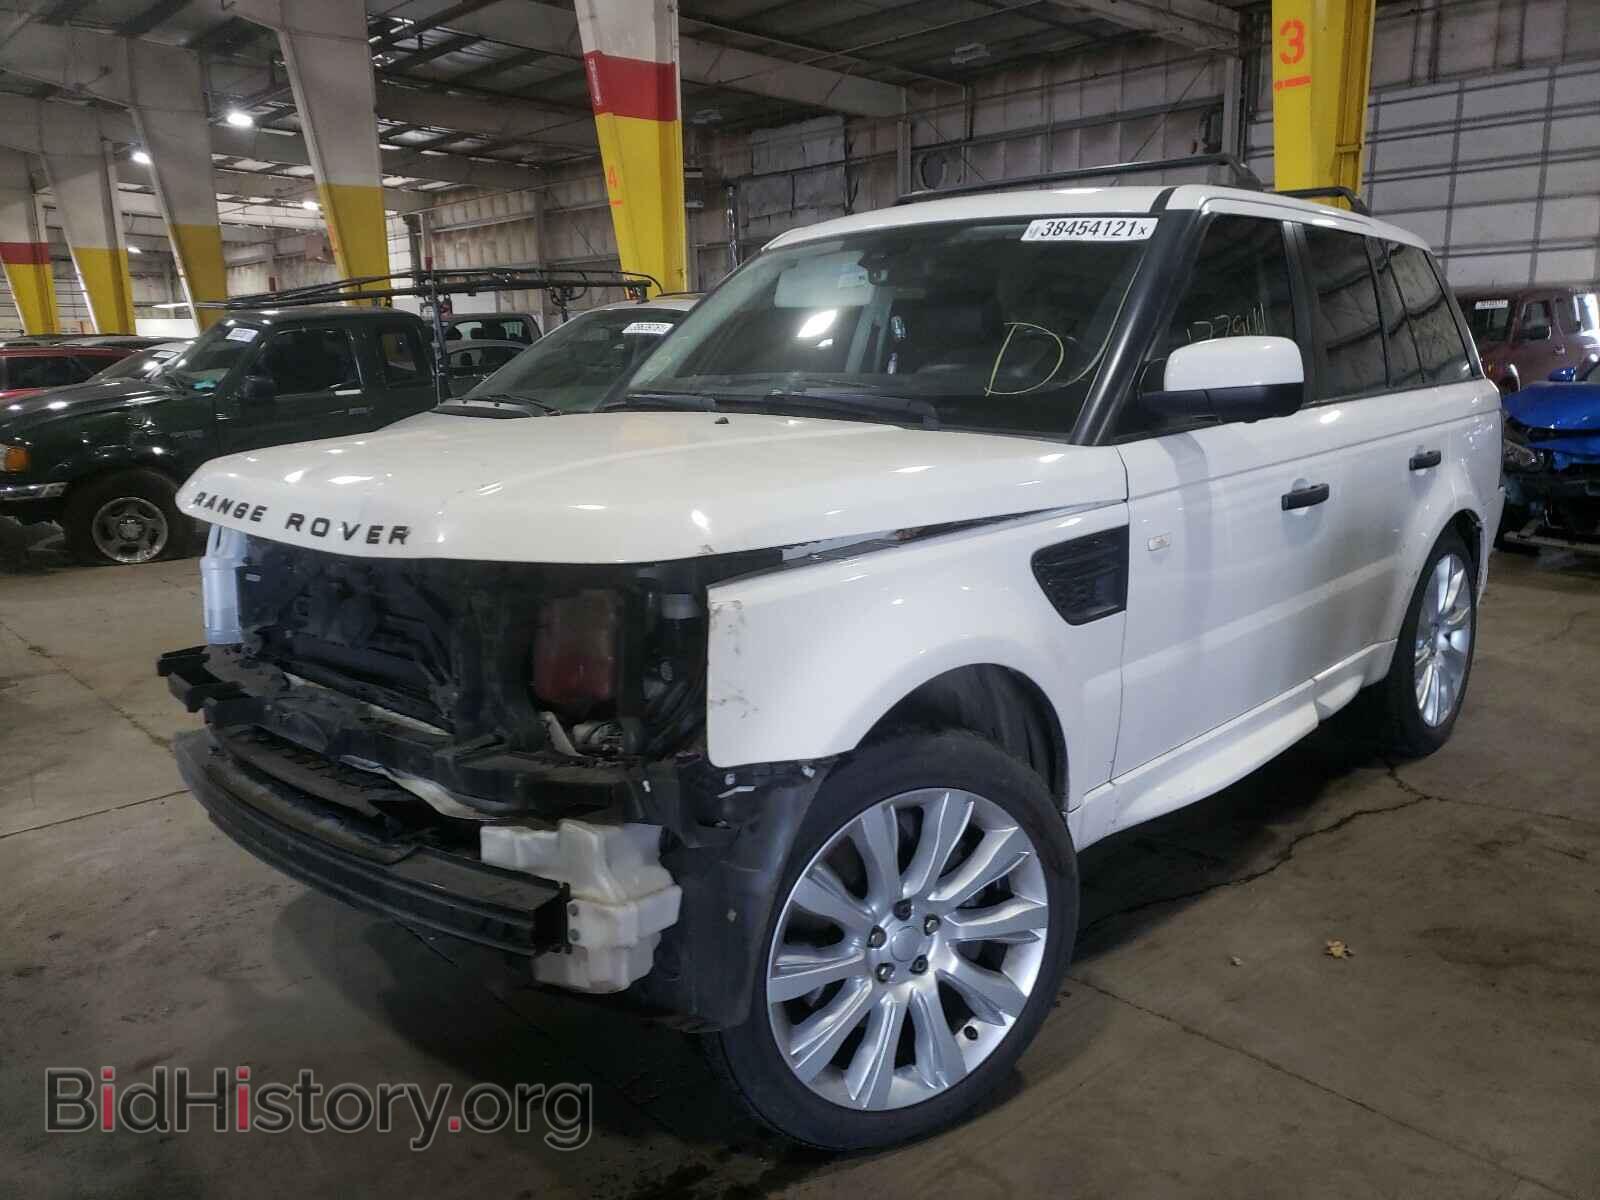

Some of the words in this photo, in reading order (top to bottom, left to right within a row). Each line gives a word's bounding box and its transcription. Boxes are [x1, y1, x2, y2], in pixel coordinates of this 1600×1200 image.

[1280, 18, 1307, 65] 3
[192, 491, 268, 523] RANGE
[285, 512, 411, 546] ROVER
